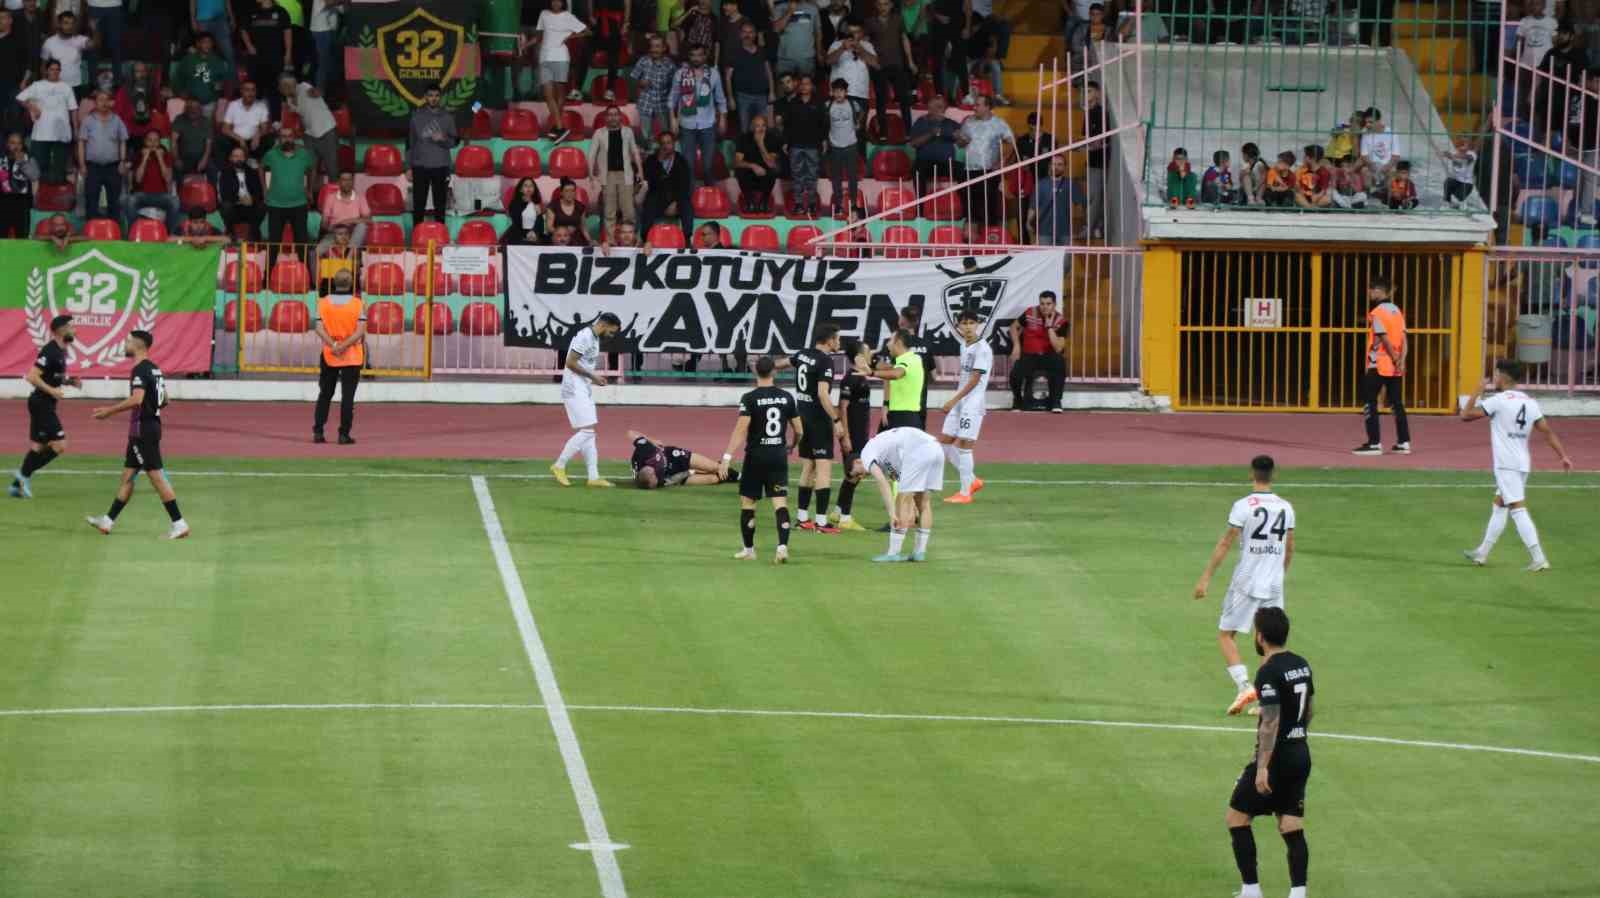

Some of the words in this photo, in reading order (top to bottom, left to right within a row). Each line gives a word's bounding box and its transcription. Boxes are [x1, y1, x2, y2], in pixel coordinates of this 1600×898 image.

[396, 30, 444, 68] 32
[65, 271, 118, 314] 32
[1258, 301, 1271, 317] H
[643, 292, 926, 352] AYNEN
[798, 363, 808, 391] 6
[765, 406, 781, 437] 8
[1515, 403, 1526, 430] 4
[1251, 507, 1286, 541] 24
[1293, 683, 1307, 723] 7
